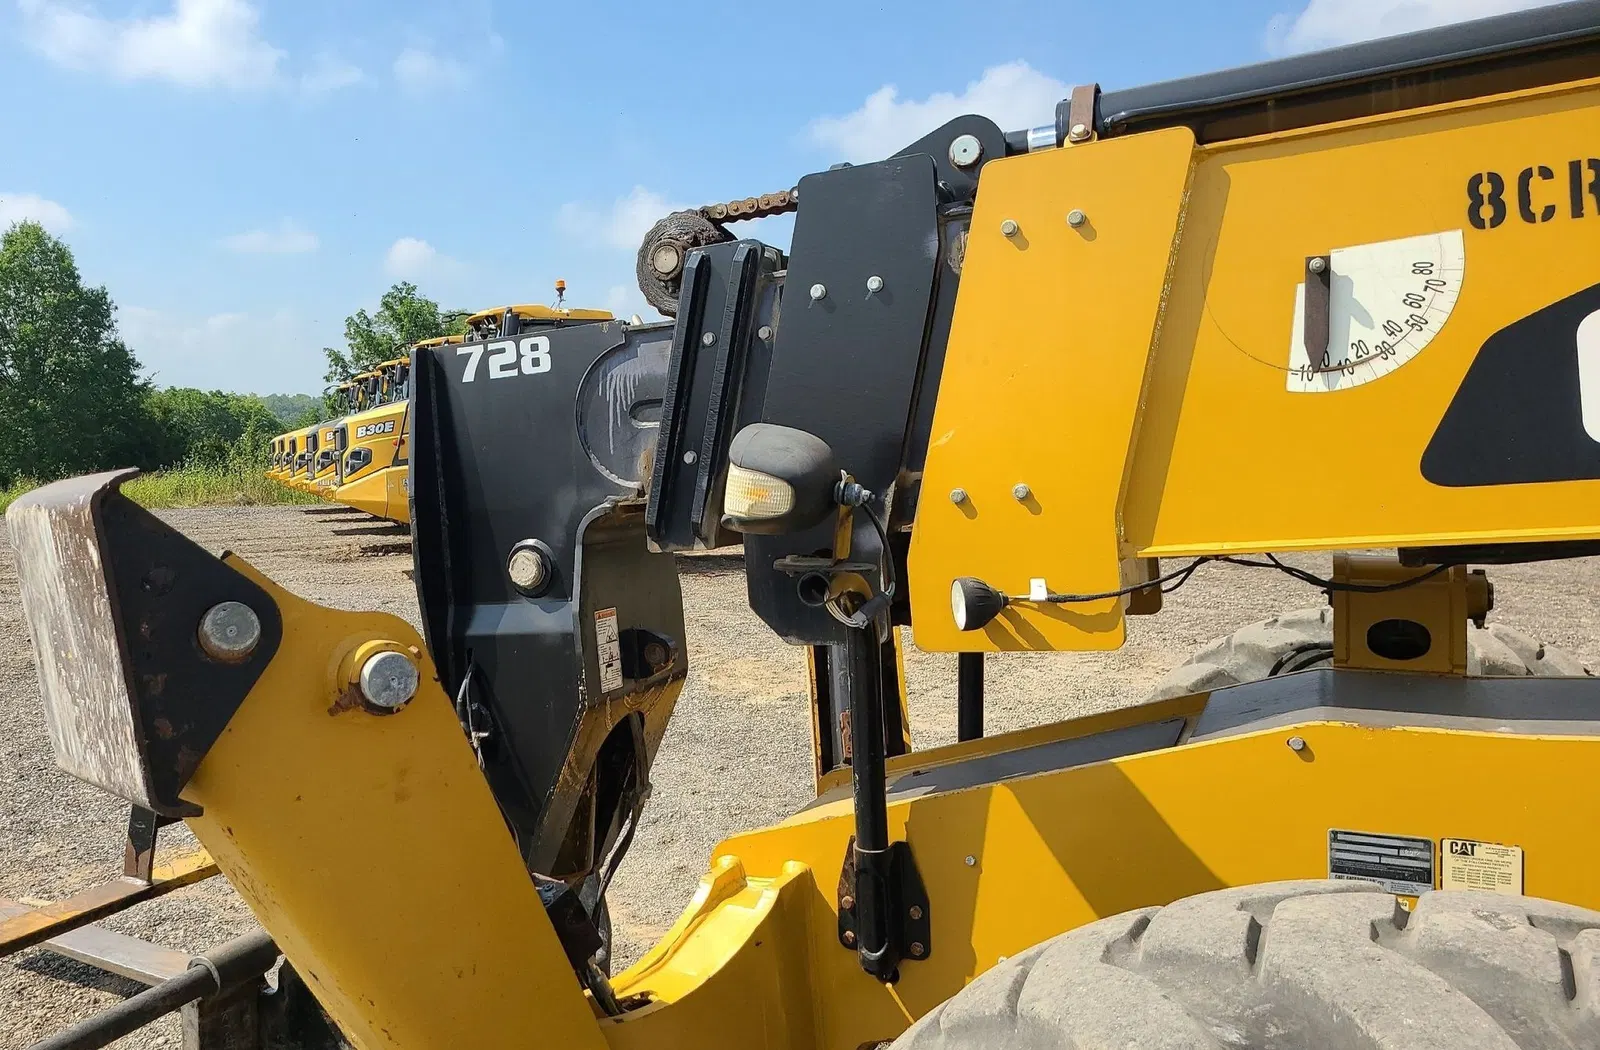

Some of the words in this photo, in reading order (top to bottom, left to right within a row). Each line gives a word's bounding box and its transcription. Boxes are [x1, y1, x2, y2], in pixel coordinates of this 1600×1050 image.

[1411, 261, 1434, 276] 80
[1423, 278, 1447, 294] 70
[1402, 292, 1426, 309] 60
[1382, 319, 1403, 338] 40
[1404, 313, 1429, 332] 50
[456, 335, 552, 383] 728
[1350, 339, 1370, 360] 20
[1374, 340, 1396, 361] 30
[1337, 357, 1355, 377] 10
[356, 420, 395, 439] B30E
[1450, 841, 1477, 857] CAT
